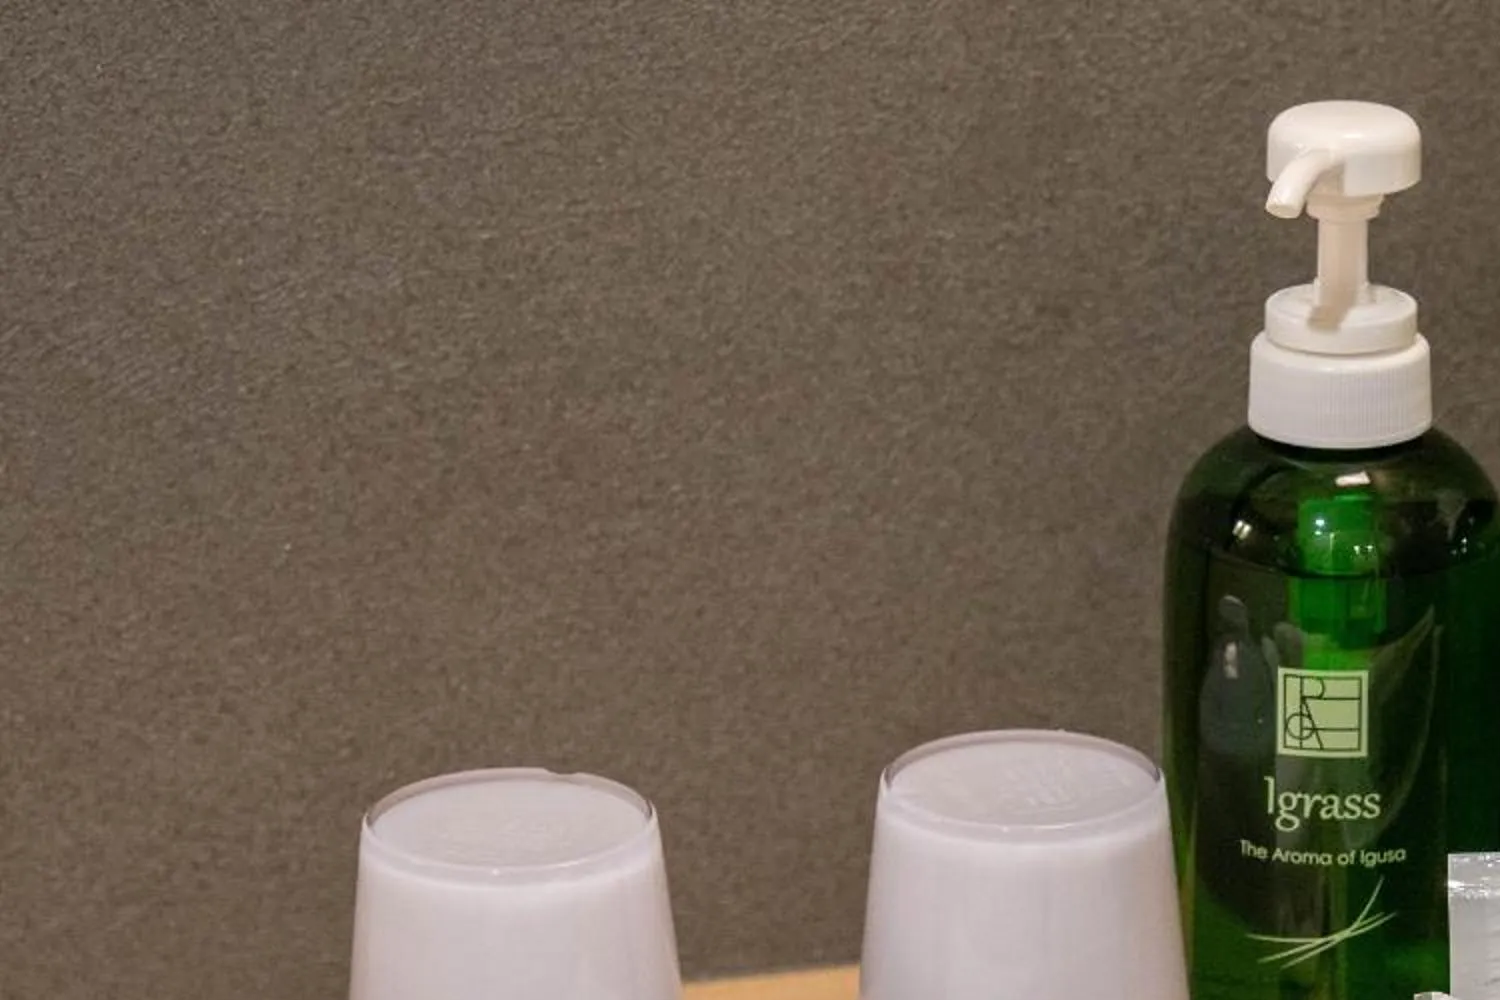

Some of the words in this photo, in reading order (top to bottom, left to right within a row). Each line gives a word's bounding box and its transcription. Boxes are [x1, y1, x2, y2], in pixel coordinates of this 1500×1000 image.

[1240, 839, 1268, 860] The
[1272, 847, 1333, 866] Aroma
[1337, 850, 1356, 866] of
